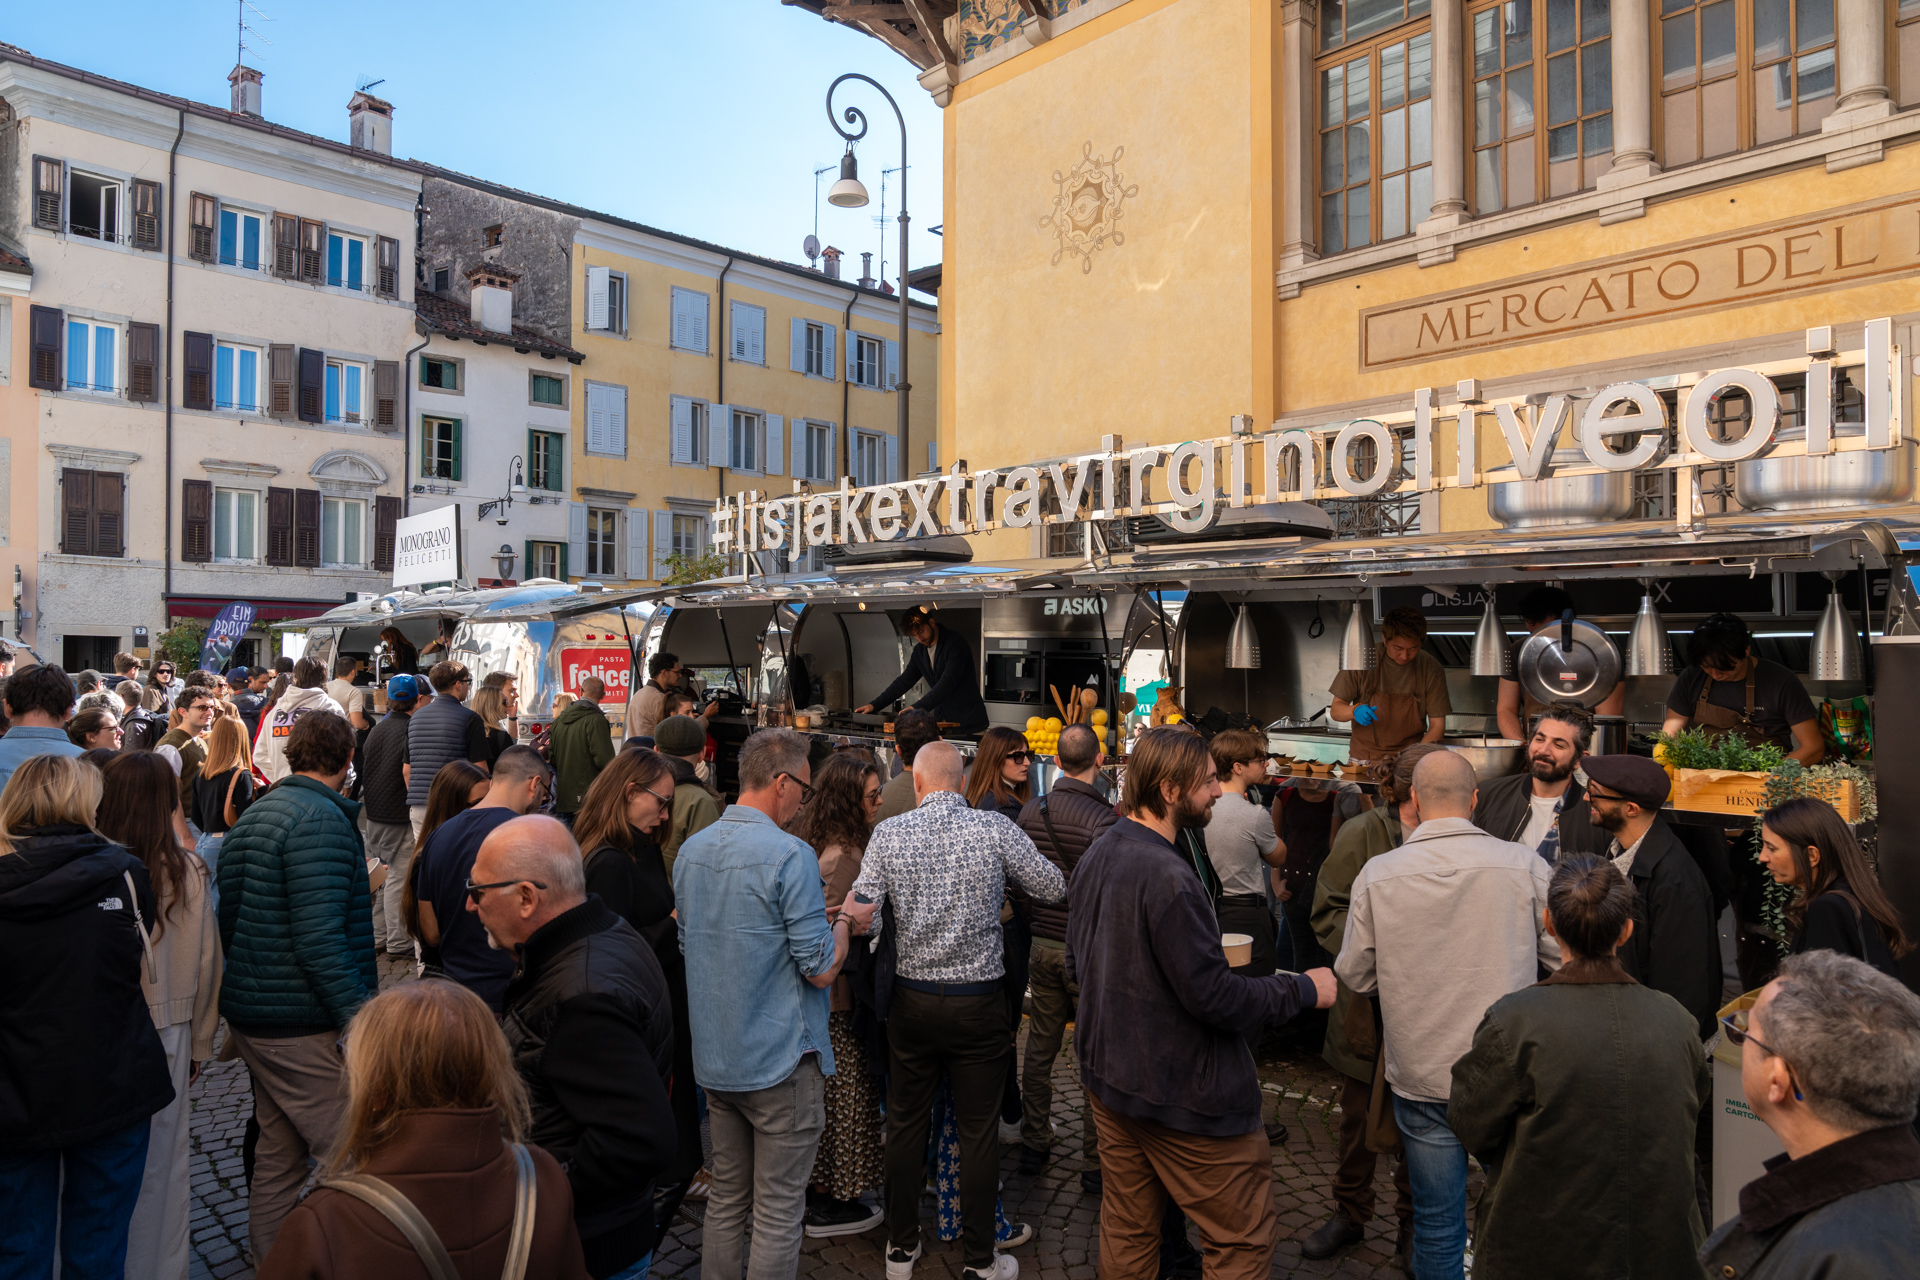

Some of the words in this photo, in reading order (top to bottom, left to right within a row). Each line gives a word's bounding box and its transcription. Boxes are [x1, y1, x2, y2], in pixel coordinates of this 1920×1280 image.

[1416, 259, 1700, 349] MERCATO
[1735, 225, 1879, 290] DEL
[399, 526, 451, 554] MONOGRANO
[398, 548, 451, 568] FELICETTI
[231, 605, 252, 621] EIN
[1060, 597, 1108, 616] ASKO
[569, 663, 630, 690] felice
[1726, 795, 1770, 808] HENRI
[1739, 788, 1763, 796] Champ
[1726, 1098, 1751, 1110] IMBAL
